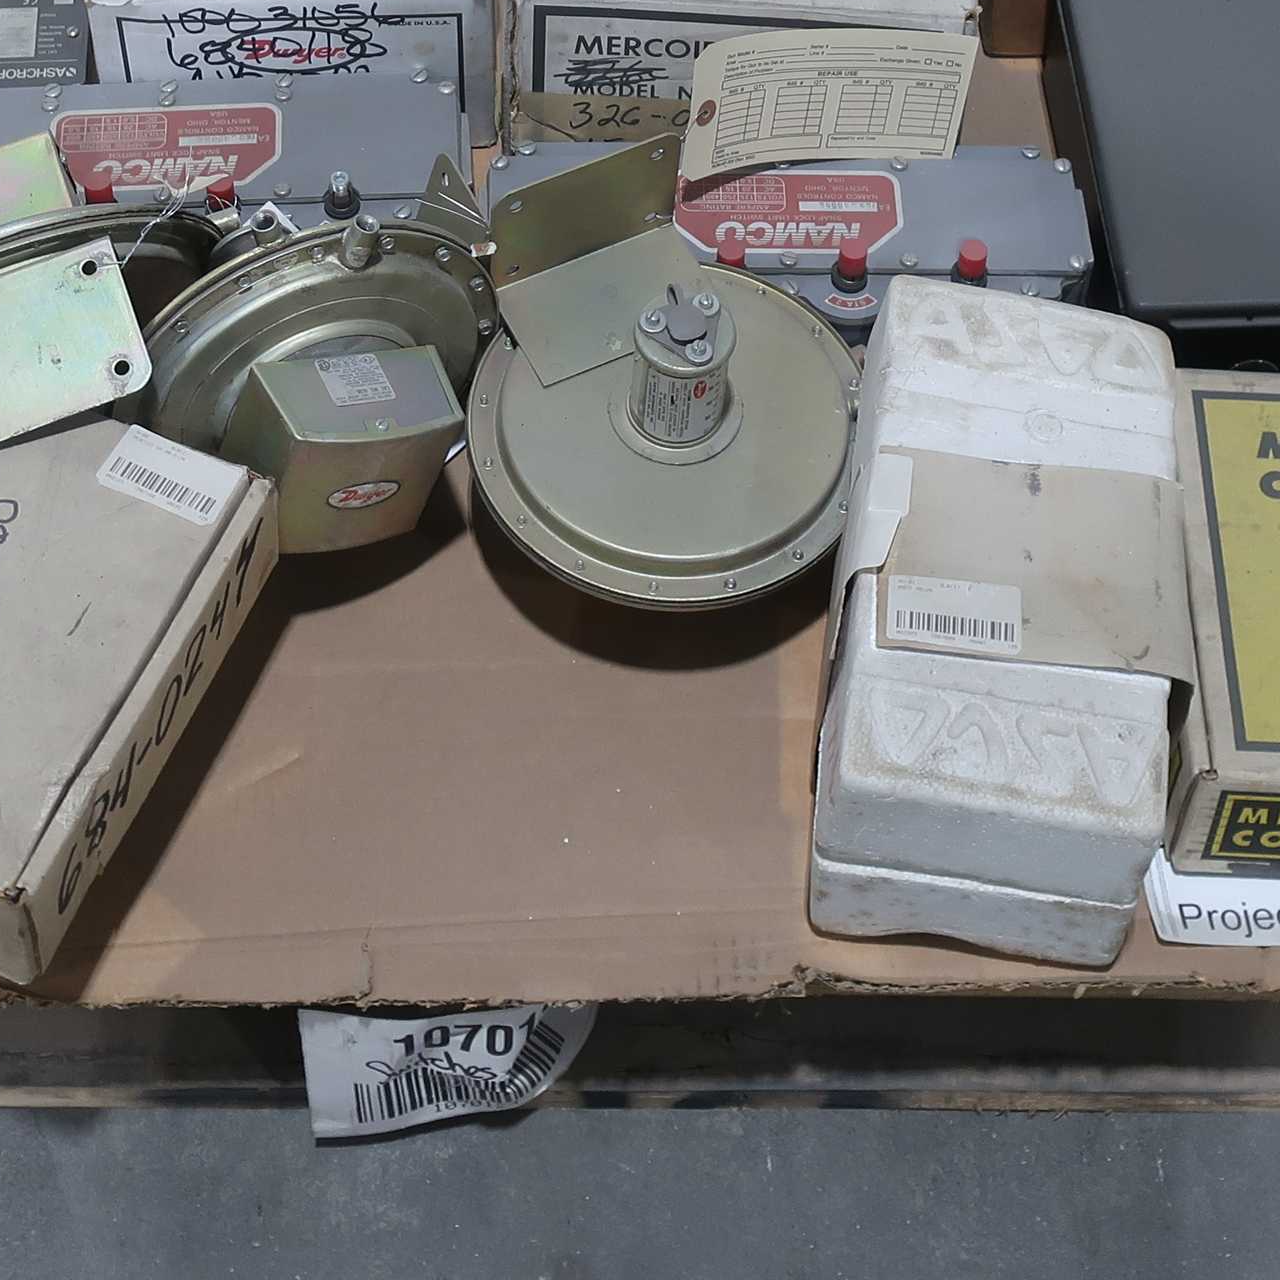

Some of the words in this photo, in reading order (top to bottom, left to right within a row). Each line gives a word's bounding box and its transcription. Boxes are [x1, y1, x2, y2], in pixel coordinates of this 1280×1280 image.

[244, 39, 344, 64] Dwyer
[573, 83, 660, 99] MODEL
[715, 221, 862, 247] NAMCO
